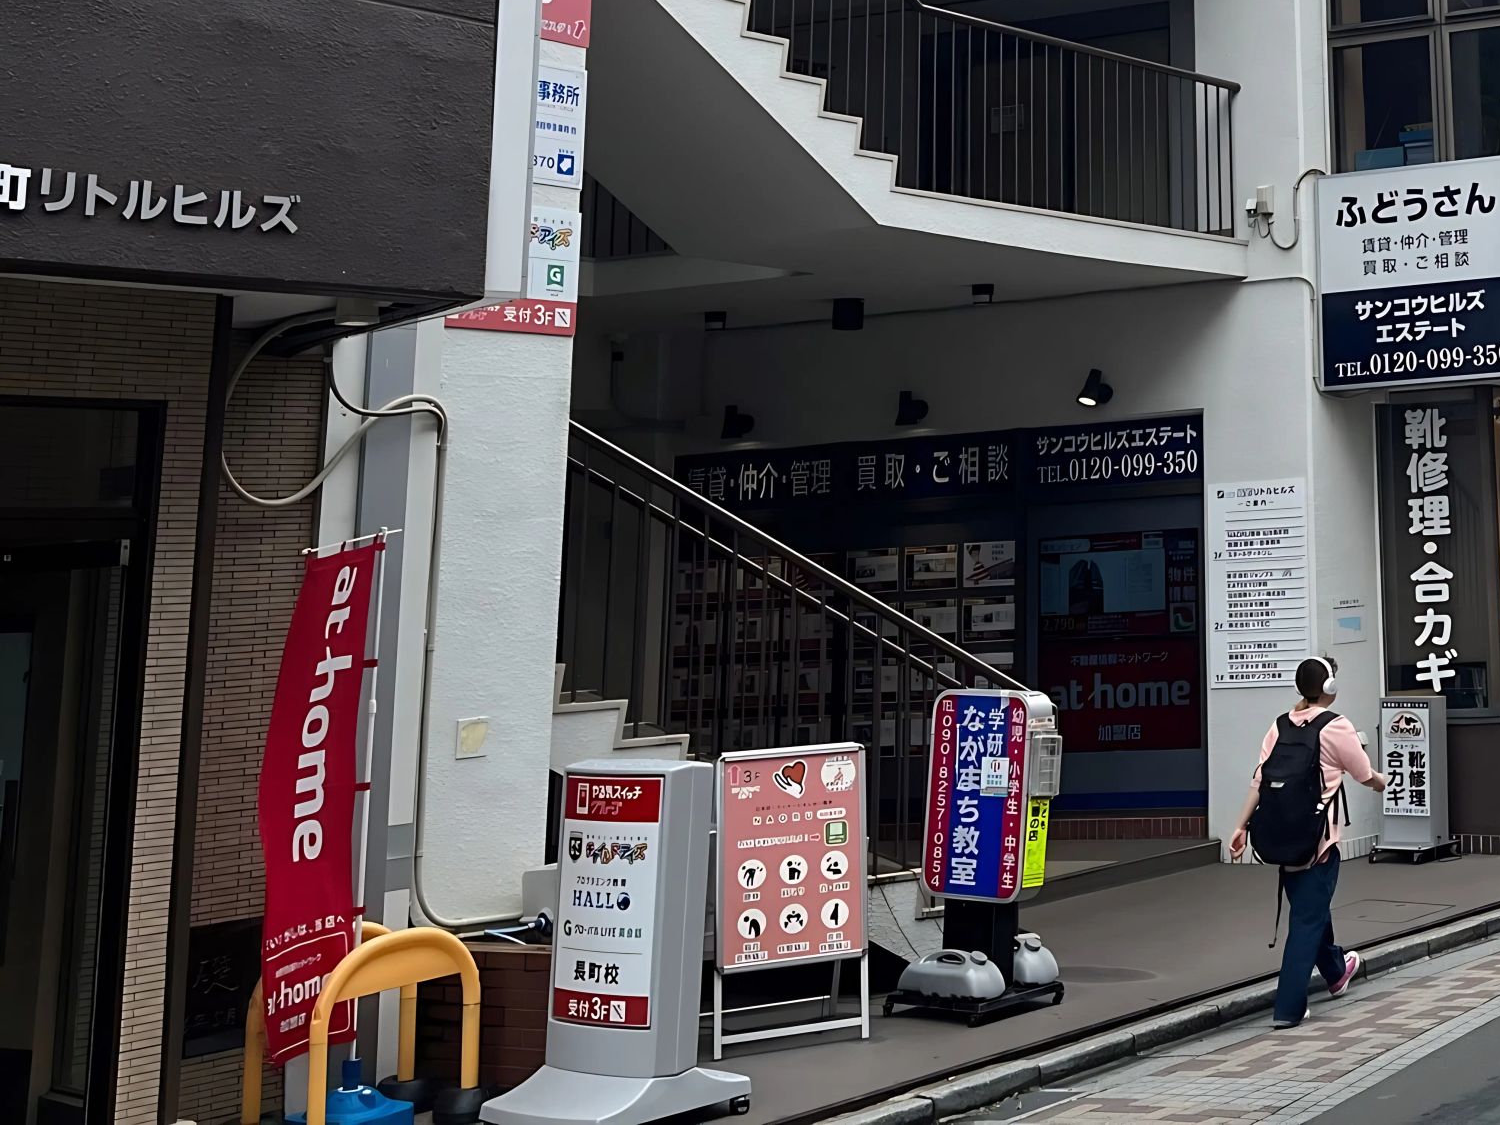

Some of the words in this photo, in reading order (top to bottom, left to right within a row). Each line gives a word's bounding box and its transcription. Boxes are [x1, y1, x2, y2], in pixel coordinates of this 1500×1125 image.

[538, 80, 580, 107] 事務所
[1336, 182, 1496, 228] ふどうさん
[1362, 228, 1469, 254] 賃貸・仲介・管理
[1363, 251, 1470, 276] 買取・ご相談
[1355, 289, 1486, 321] サンコウヒルズ
[1376, 317, 1466, 343] エステート
[1036, 424, 1197, 456] サンコウヒルズエステート
[857, 443, 1008, 491] 買取・ご相談
[1036, 449, 1198, 484] TEL.0120-099-350
[1404, 408, 1458, 693] 靴修理・合カギ
[324, 565, 357, 640] at
[942, 700, 954, 712] TEL
[1050, 679, 1084, 711] at
[1088, 673, 1191, 710] home
[292, 646, 353, 863] home
[949, 705, 985, 886] ながまち教室
[1387, 750, 1405, 807] 合カギ
[1408, 751, 1426, 807] 靴修理
[1001, 707, 1025, 890] 幼児・小学生・中学生
[574, 960, 620, 985] 長町校
[568, 996, 609, 1020] 受付3F
